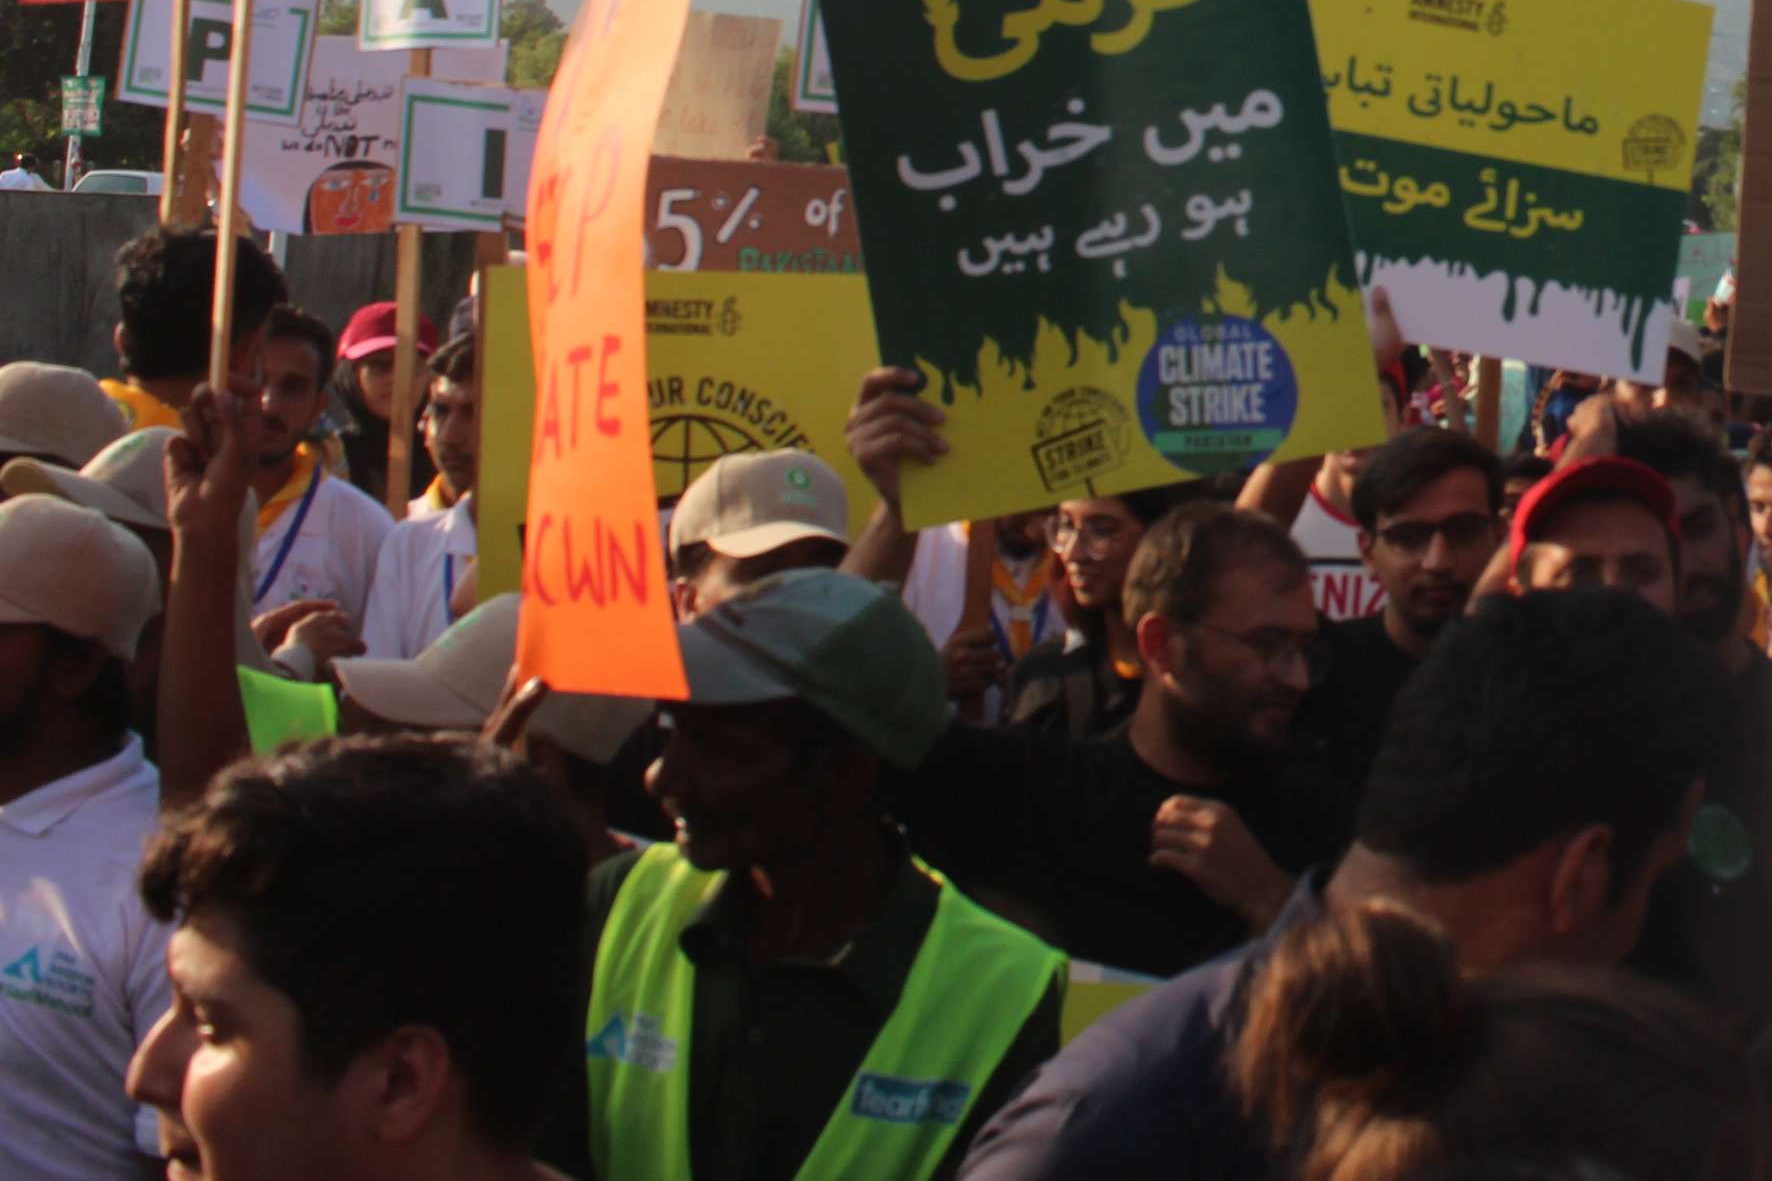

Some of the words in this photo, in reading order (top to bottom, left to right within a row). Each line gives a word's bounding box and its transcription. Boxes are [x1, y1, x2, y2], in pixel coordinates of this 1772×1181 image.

[185, 16, 232, 82] P
[324, 134, 381, 159] NOT
[896, 95, 1112, 212] خراب
[1144, 86, 1284, 166] میں
[1181, 188, 1252, 239] ہو
[1338, 159, 1452, 214] موت
[646, 187, 762, 272] 5%
[804, 187, 849, 236] of
[957, 221, 1055, 276] ہیں
[1075, 202, 1162, 277] رہے
[646, 299, 714, 320] MNESTY
[1173, 322, 1252, 344] GLOBAL
[1158, 339, 1274, 385] CLIMATE
[1168, 383, 1267, 427] STRIKE
